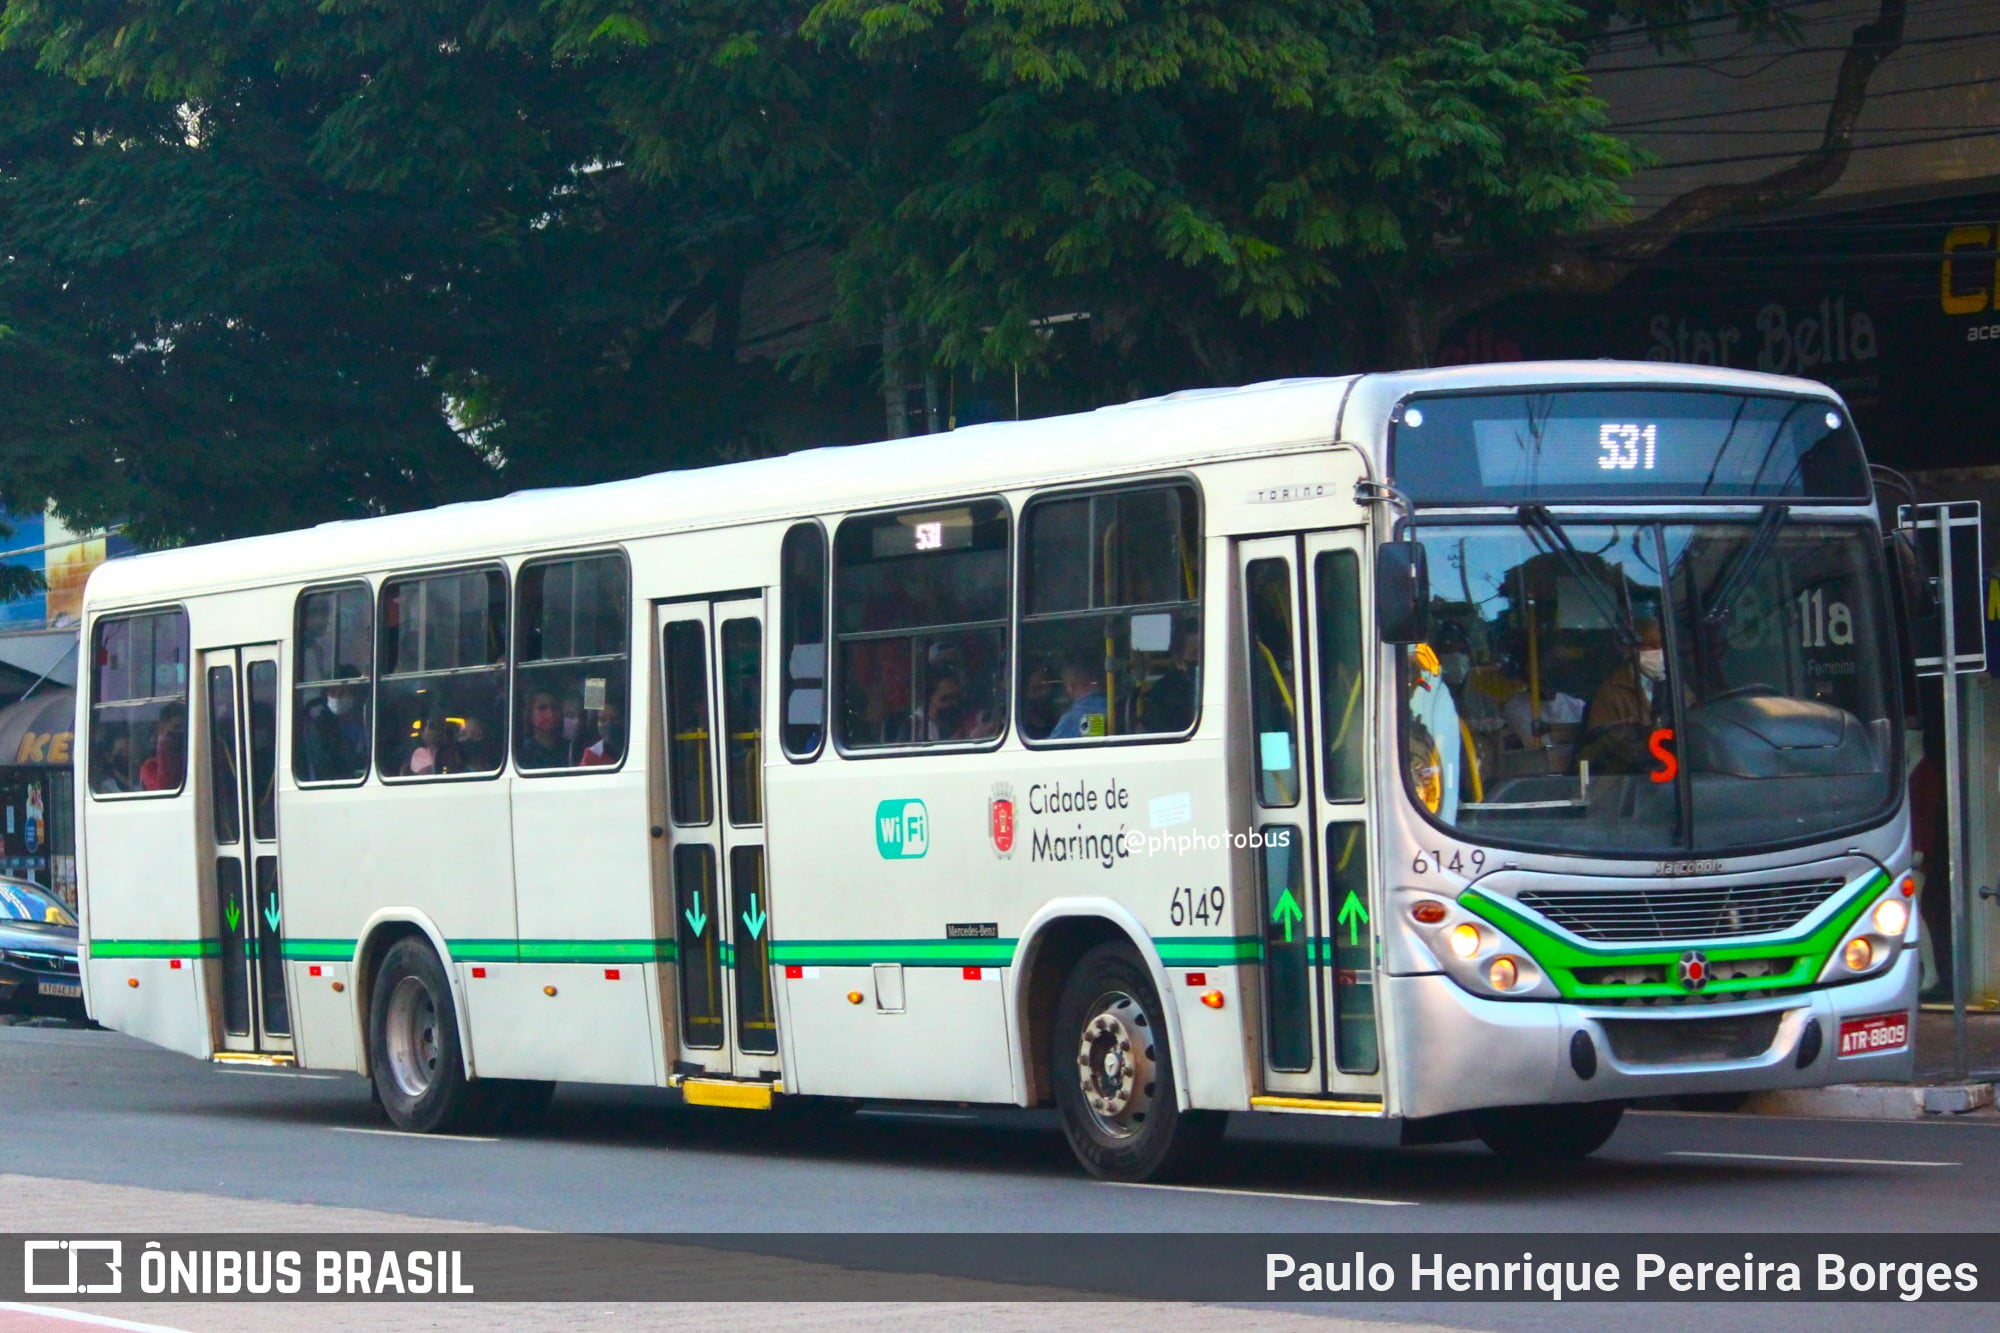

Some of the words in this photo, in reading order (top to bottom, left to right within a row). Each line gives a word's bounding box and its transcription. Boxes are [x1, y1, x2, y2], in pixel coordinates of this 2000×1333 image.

[1648, 313, 1741, 366] Star
[1755, 296, 1879, 375] Bella
[1599, 424, 1657, 469] 531
[1258, 485, 1324, 500] TORINO
[18, 731, 75, 763] KE
[1029, 782, 1098, 815] Cidade
[1105, 778, 1130, 808] de
[1032, 823, 1129, 868] Maringá
[1412, 849, 1487, 875] 6149
[1655, 860, 1724, 875] Marcopolo
[1170, 886, 1225, 926] 6149
[948, 925, 997, 938] Mercedes-Benz
